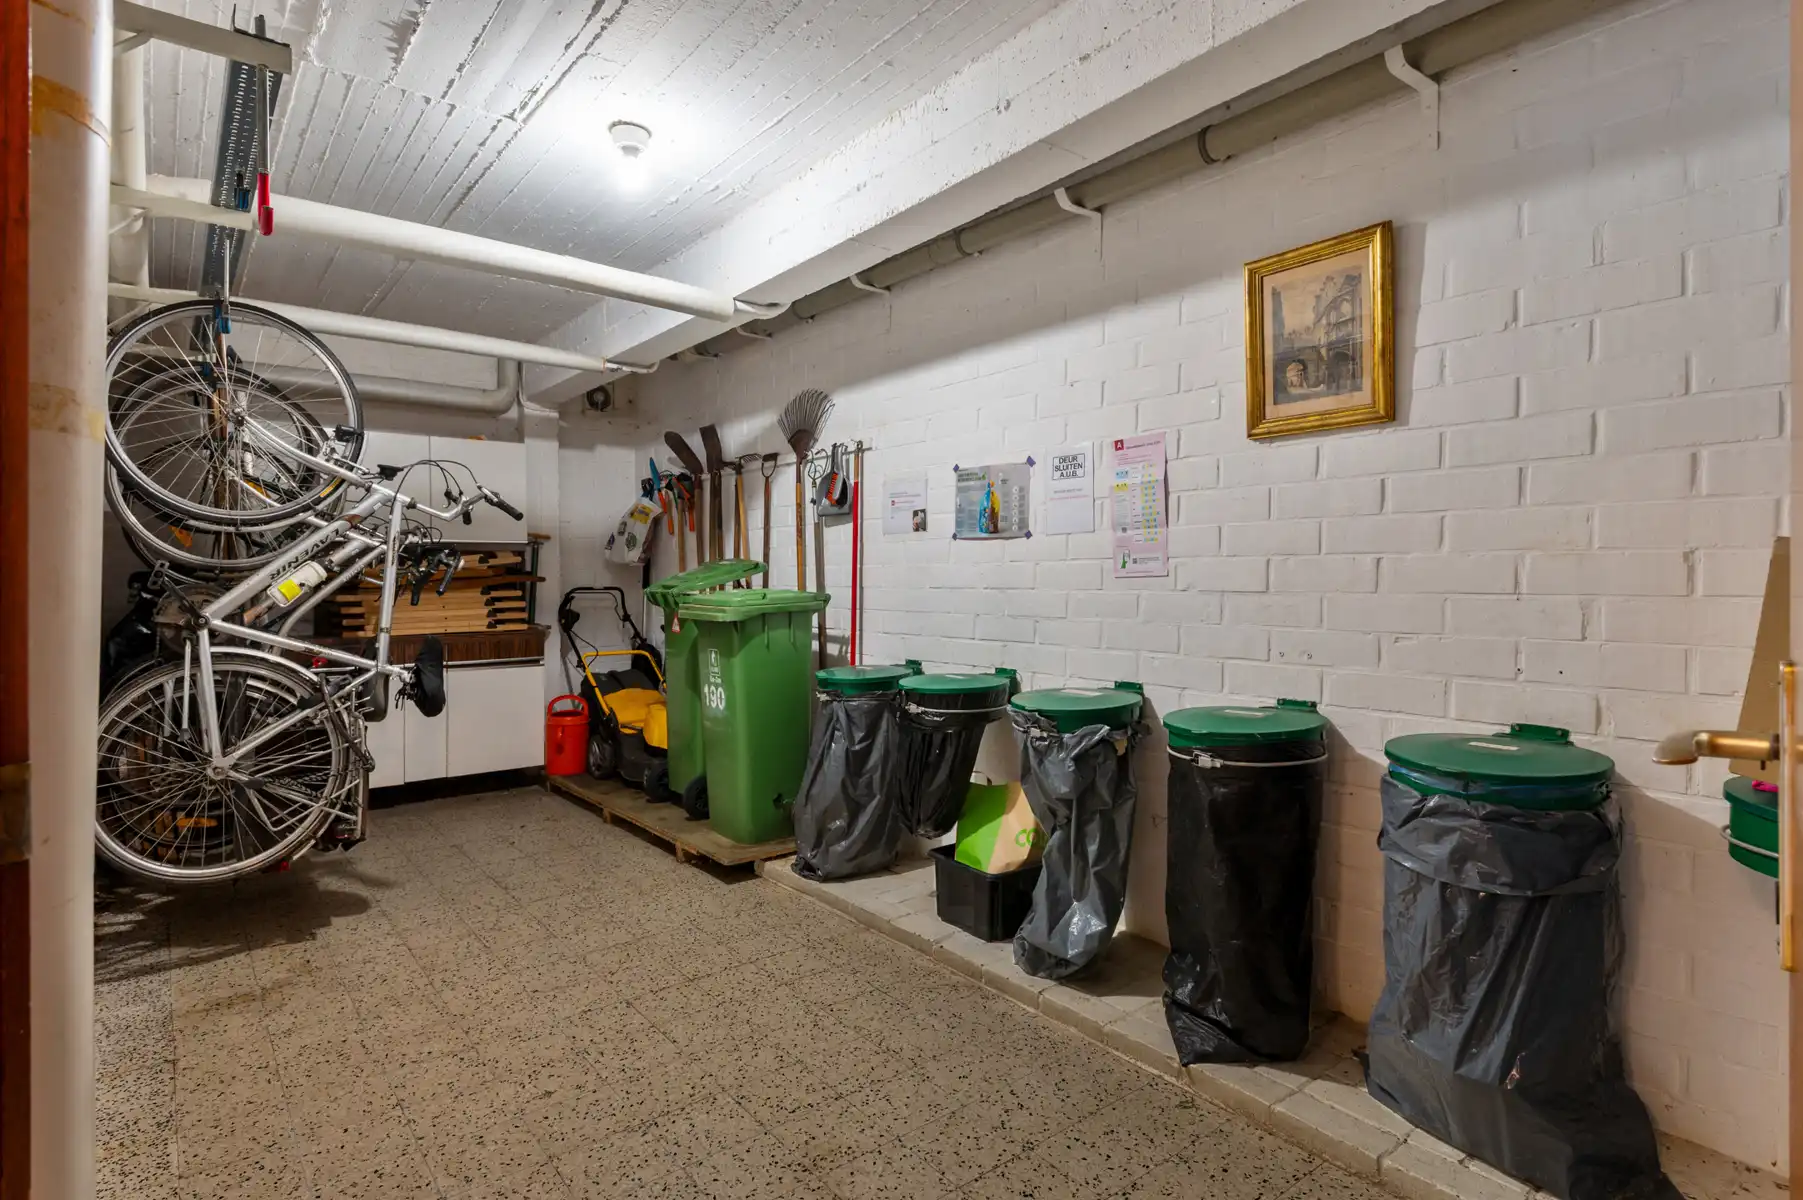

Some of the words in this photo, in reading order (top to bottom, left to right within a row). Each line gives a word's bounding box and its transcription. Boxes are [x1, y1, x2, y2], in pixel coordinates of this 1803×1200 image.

[1058, 455, 1078, 464] DEUR
[1054, 462, 1083, 472] SLUITEN
[704, 684, 725, 710] 190
